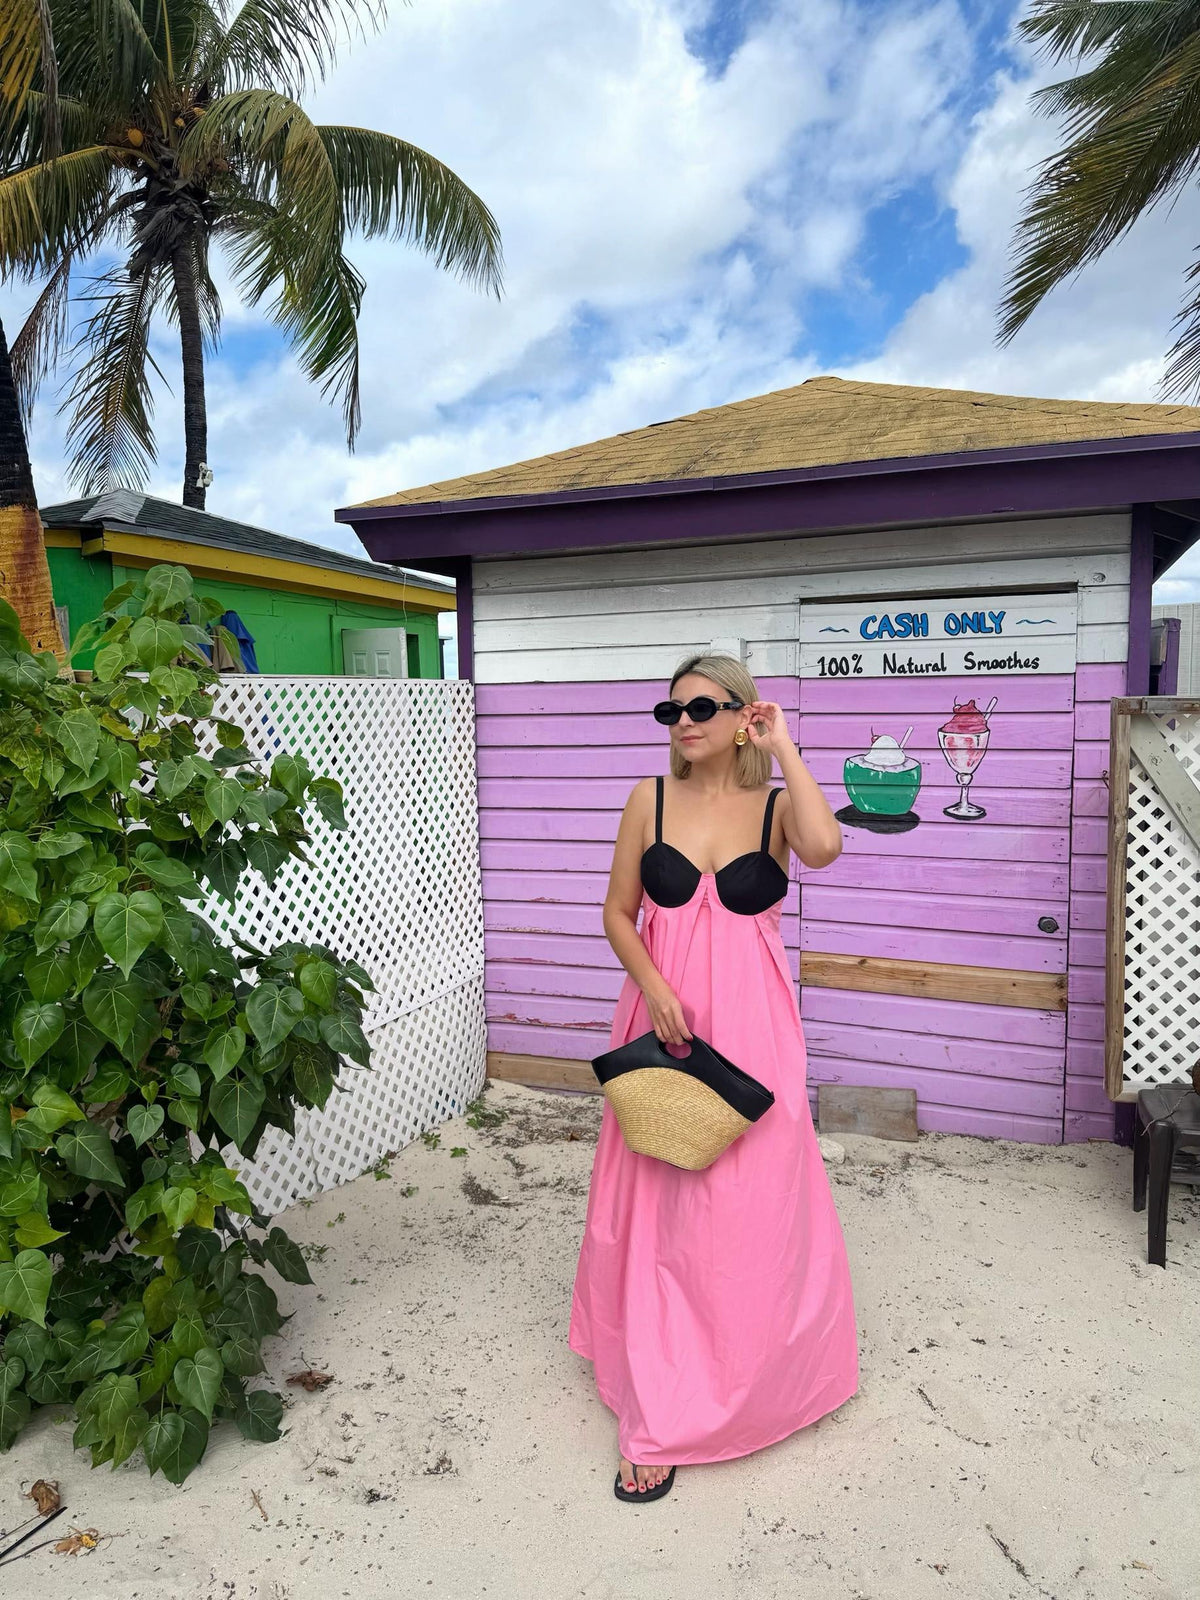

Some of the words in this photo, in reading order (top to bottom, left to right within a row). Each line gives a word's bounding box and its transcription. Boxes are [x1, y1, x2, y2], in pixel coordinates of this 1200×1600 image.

[860, 612, 929, 640] CASH
[944, 611, 1006, 636] ONLY
[818, 654, 863, 676] 100%
[883, 652, 947, 675] Natural
[963, 651, 1040, 672] Smoothes
